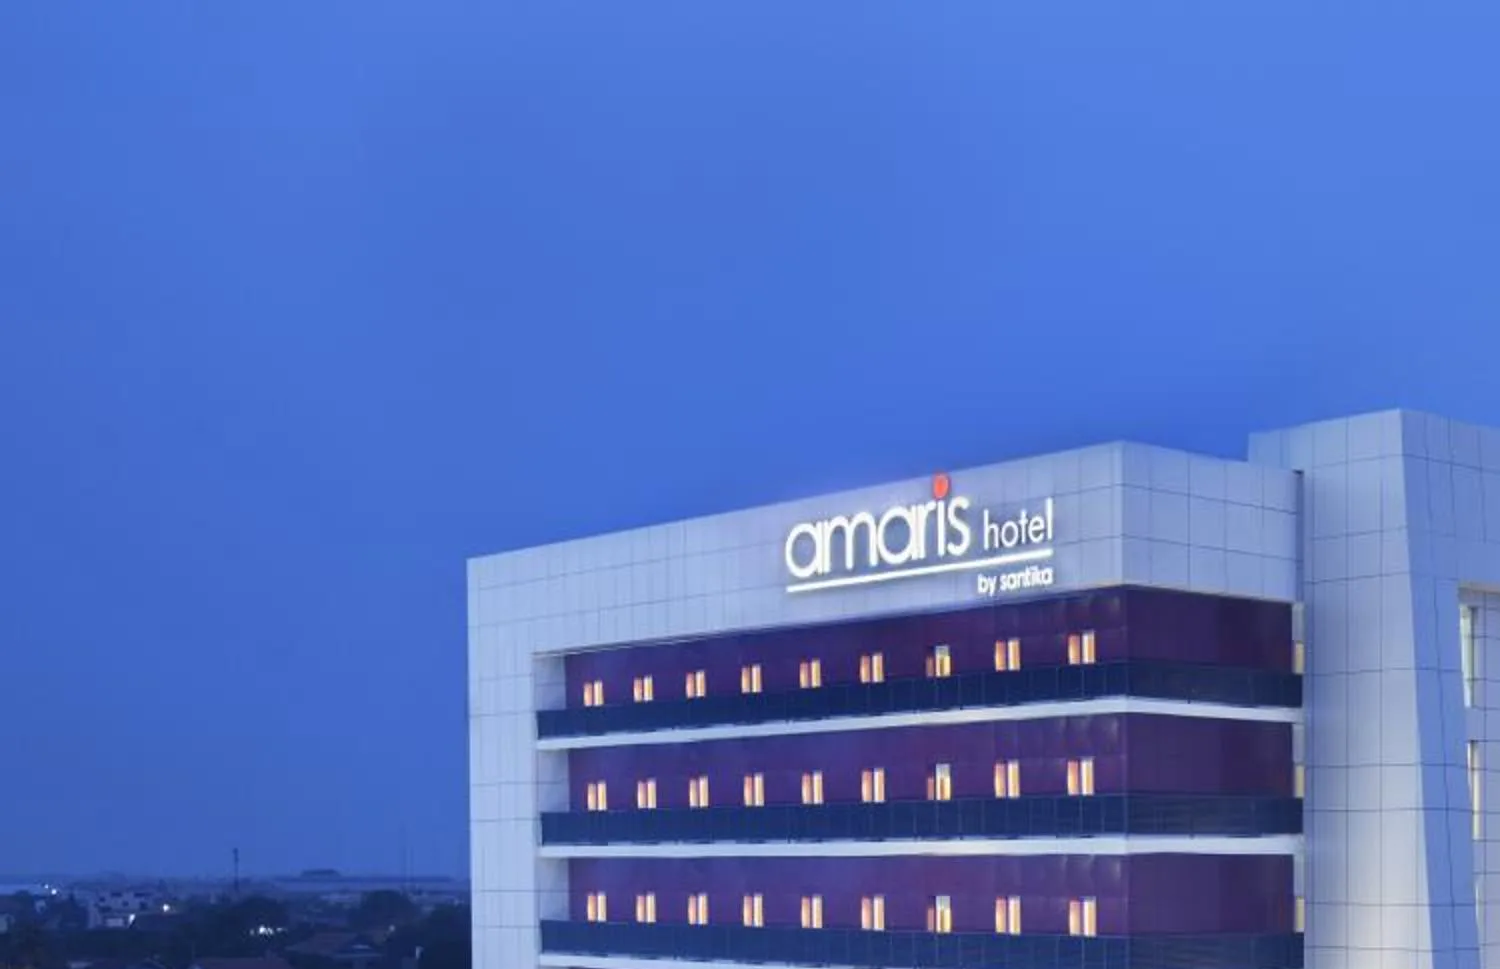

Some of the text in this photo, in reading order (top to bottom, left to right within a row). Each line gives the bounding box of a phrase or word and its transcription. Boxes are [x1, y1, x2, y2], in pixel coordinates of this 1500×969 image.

[785, 472, 1053, 578] amaris hotel
[977, 566, 1053, 597] by santika
